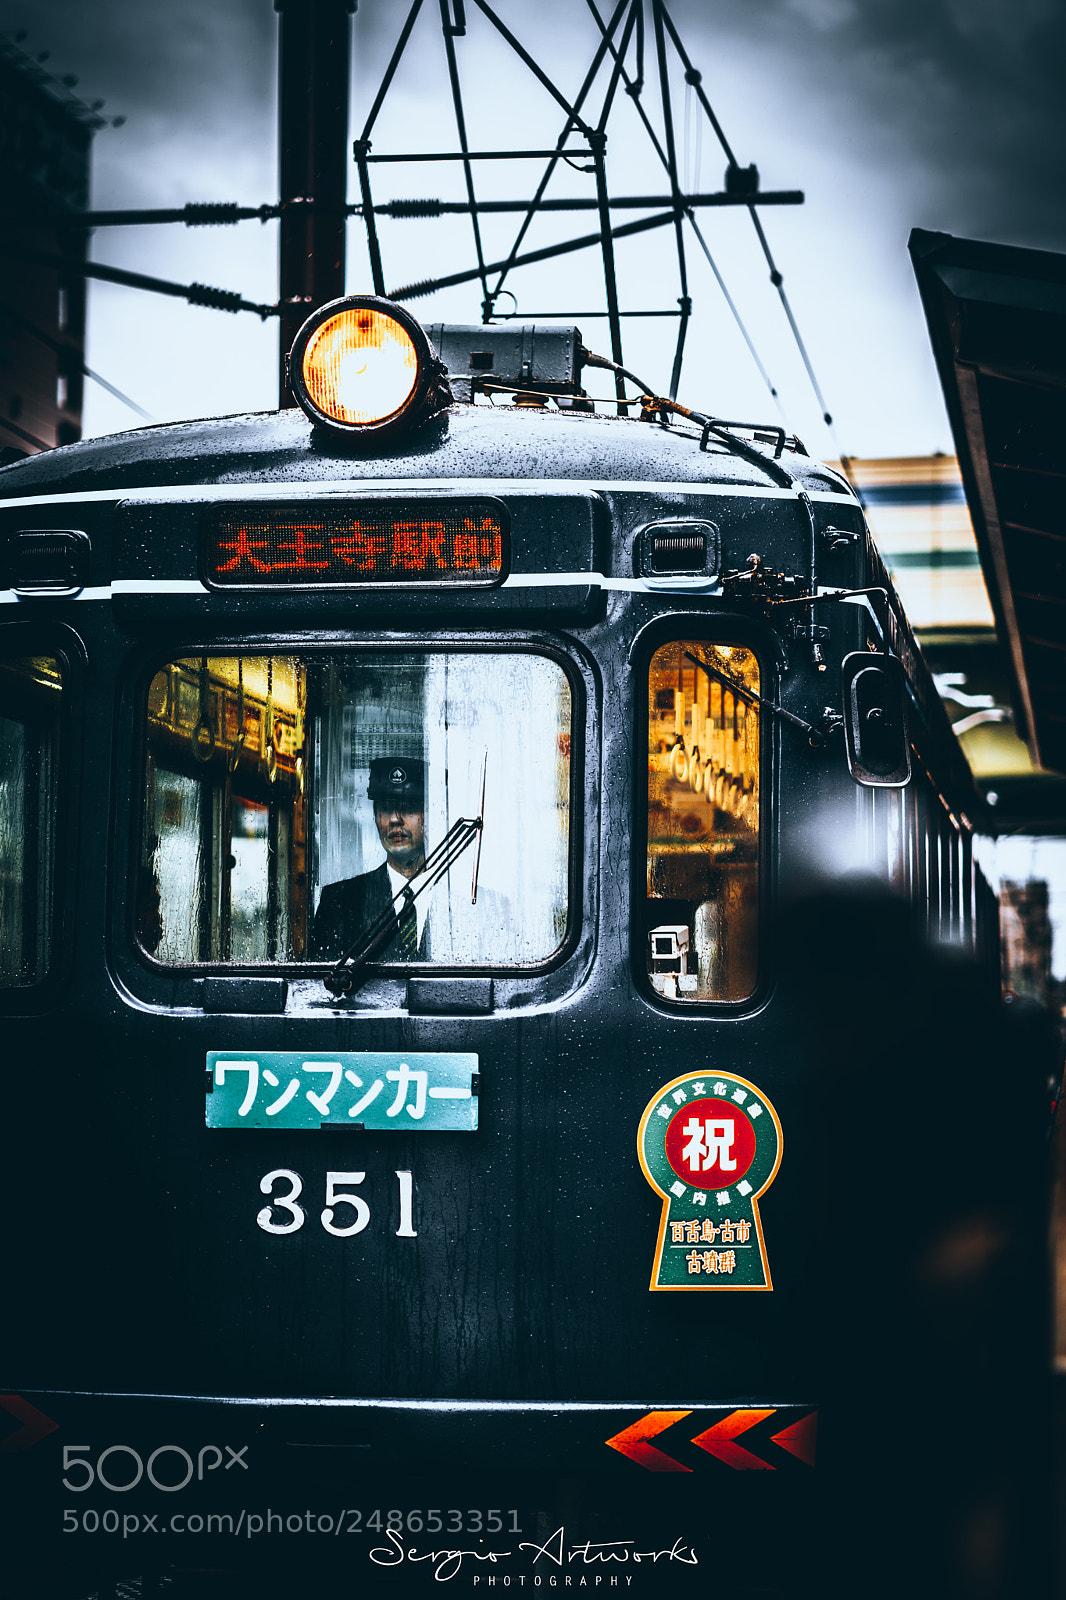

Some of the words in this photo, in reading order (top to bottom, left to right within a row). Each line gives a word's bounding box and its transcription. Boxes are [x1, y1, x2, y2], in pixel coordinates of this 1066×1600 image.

[215, 1060, 472, 1120] ワンマンカー
[682, 1117, 737, 1172] 祝
[256, 1168, 418, 1238] 351
[685, 1249, 736, 1275] 古墳群
